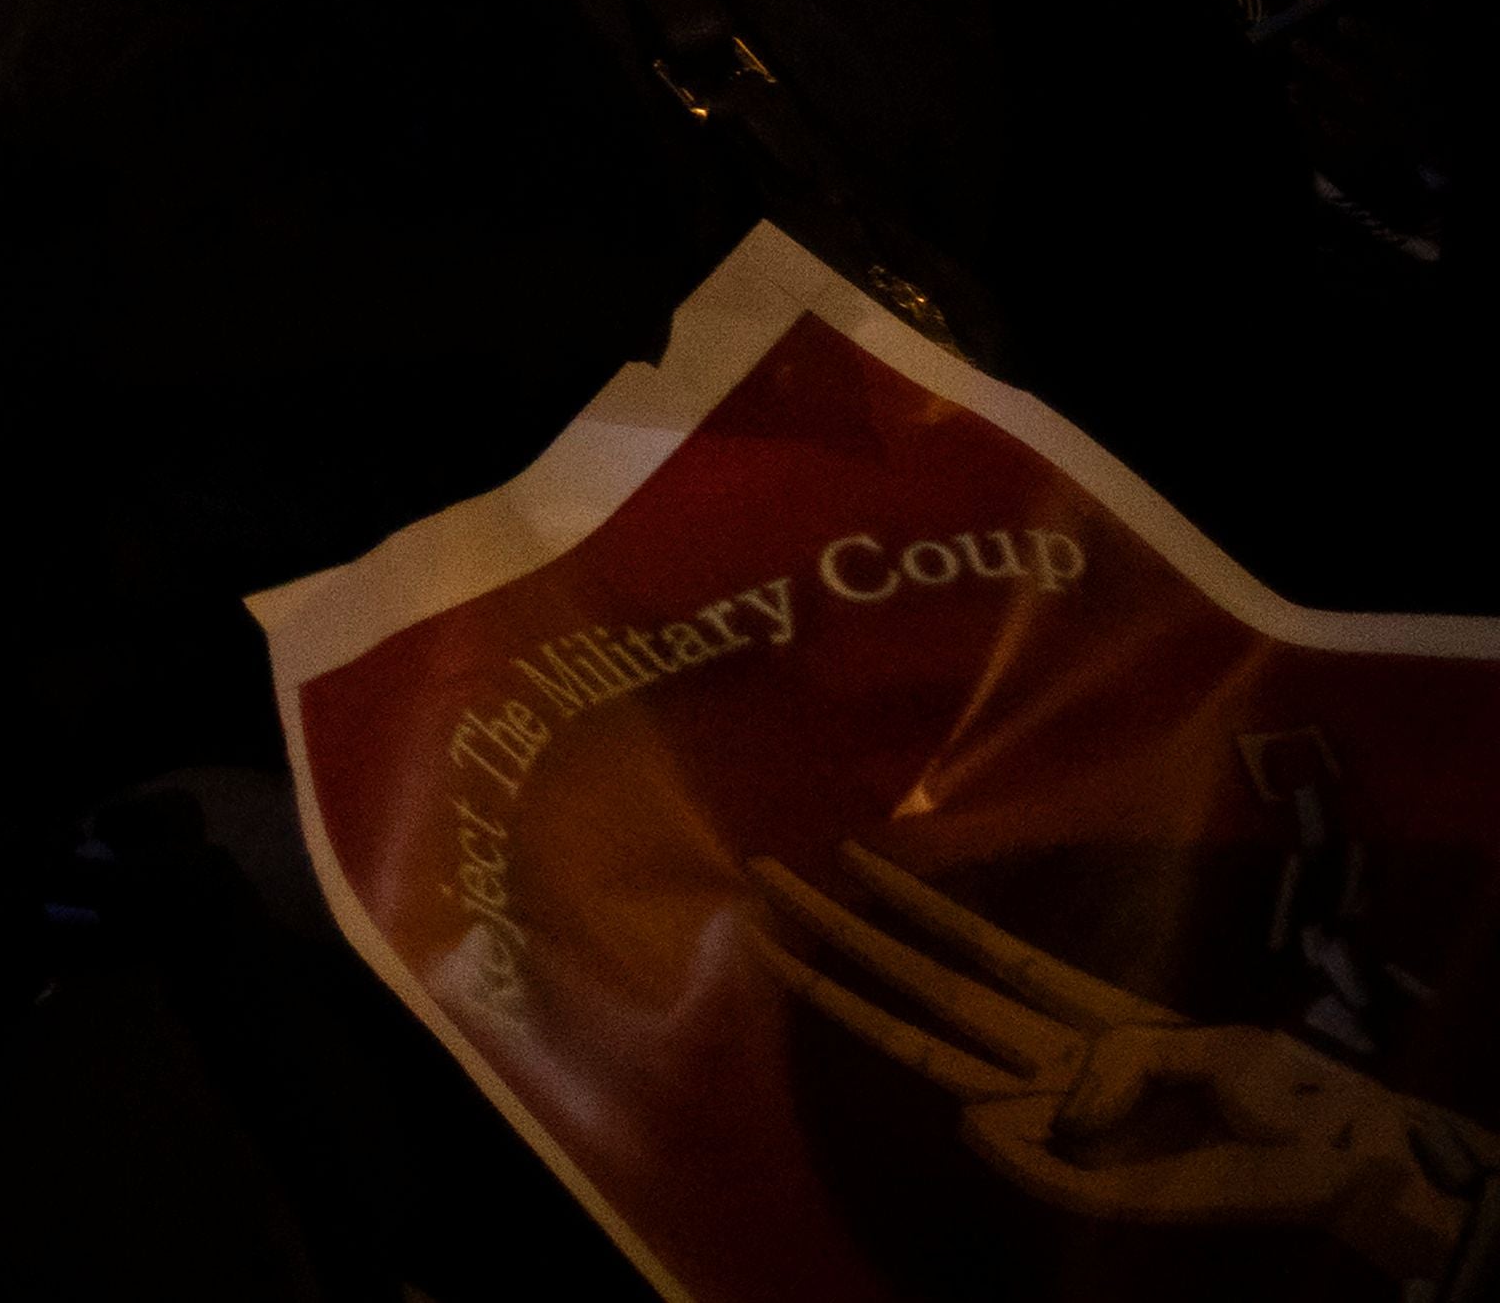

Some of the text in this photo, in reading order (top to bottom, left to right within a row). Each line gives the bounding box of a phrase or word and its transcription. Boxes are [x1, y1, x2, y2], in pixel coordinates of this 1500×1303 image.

[449, 696, 552, 800] The
[513, 576, 797, 720] Military
[816, 526, 1088, 606] Coup
